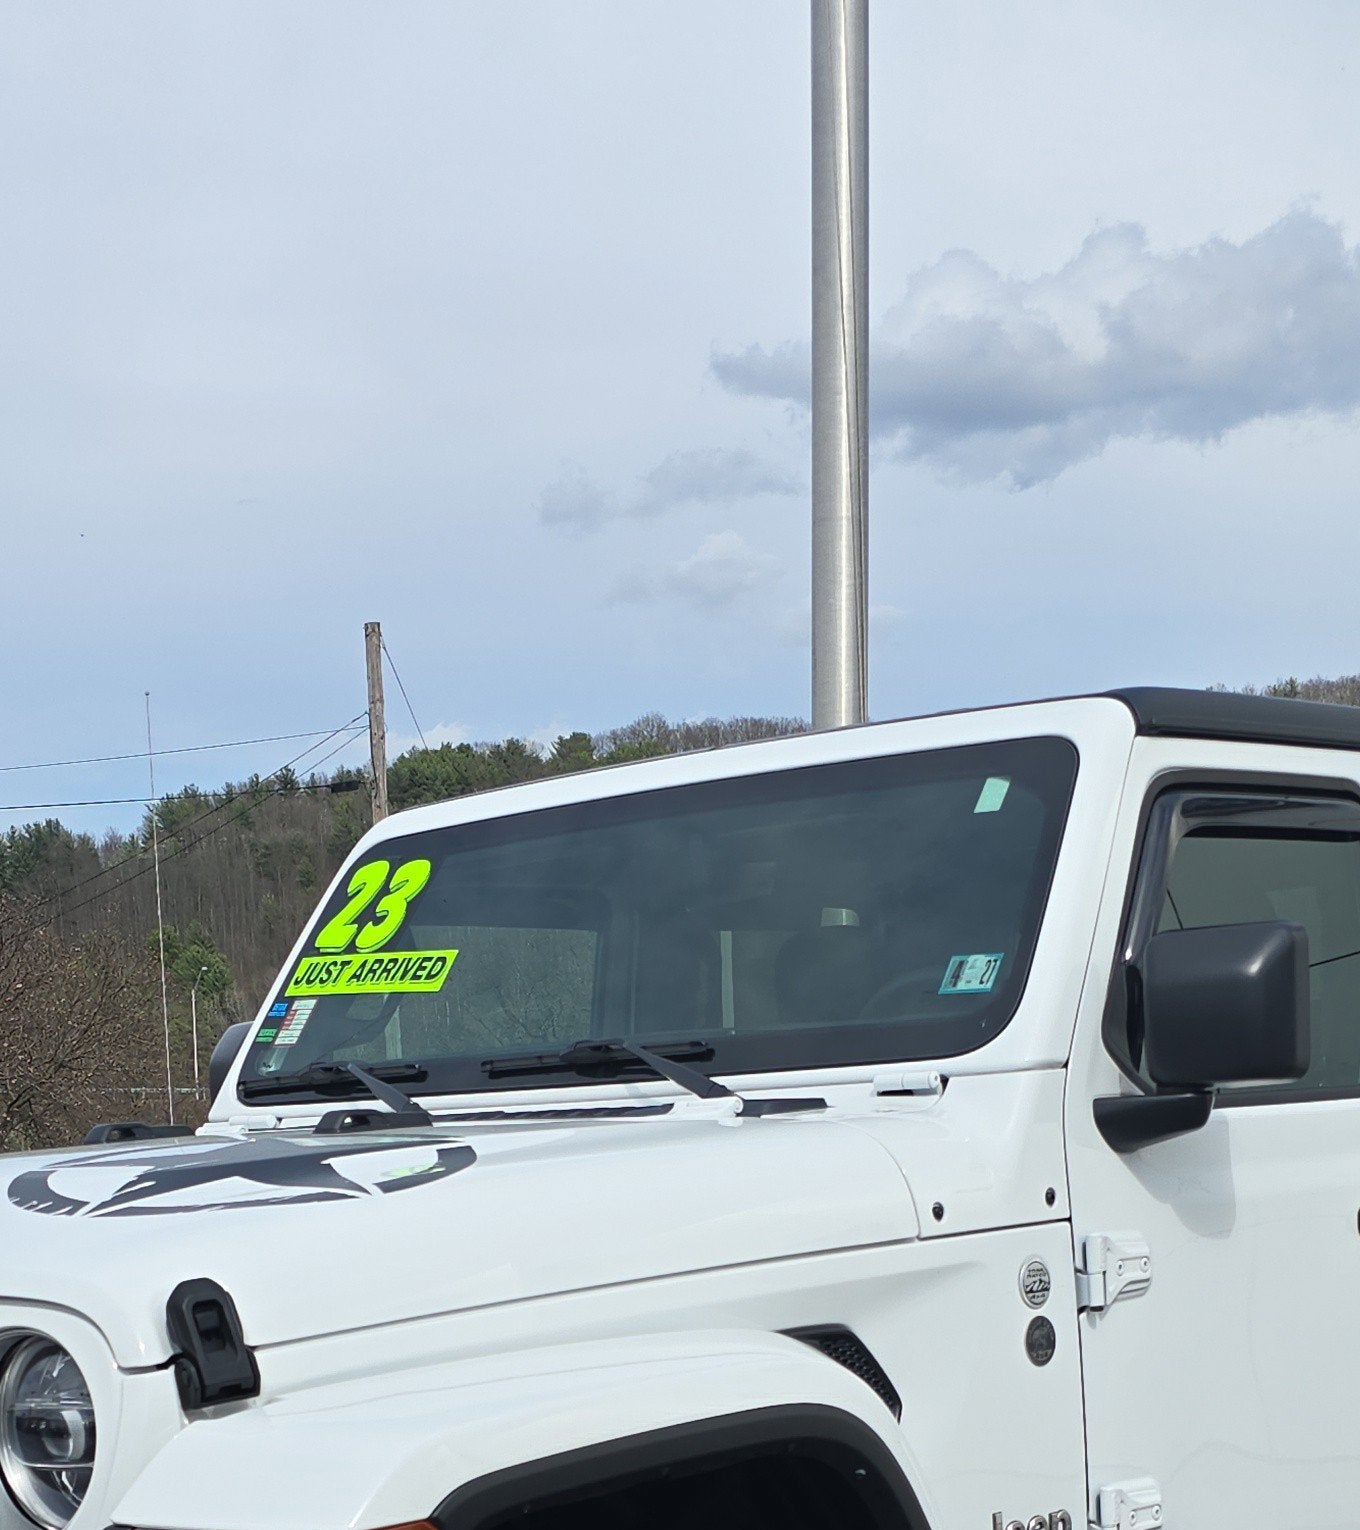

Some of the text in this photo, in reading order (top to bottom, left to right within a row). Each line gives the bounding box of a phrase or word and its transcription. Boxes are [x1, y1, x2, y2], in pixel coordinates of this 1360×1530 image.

[315, 859, 431, 953] 23
[293, 956, 447, 987] JUST ARRIVED
